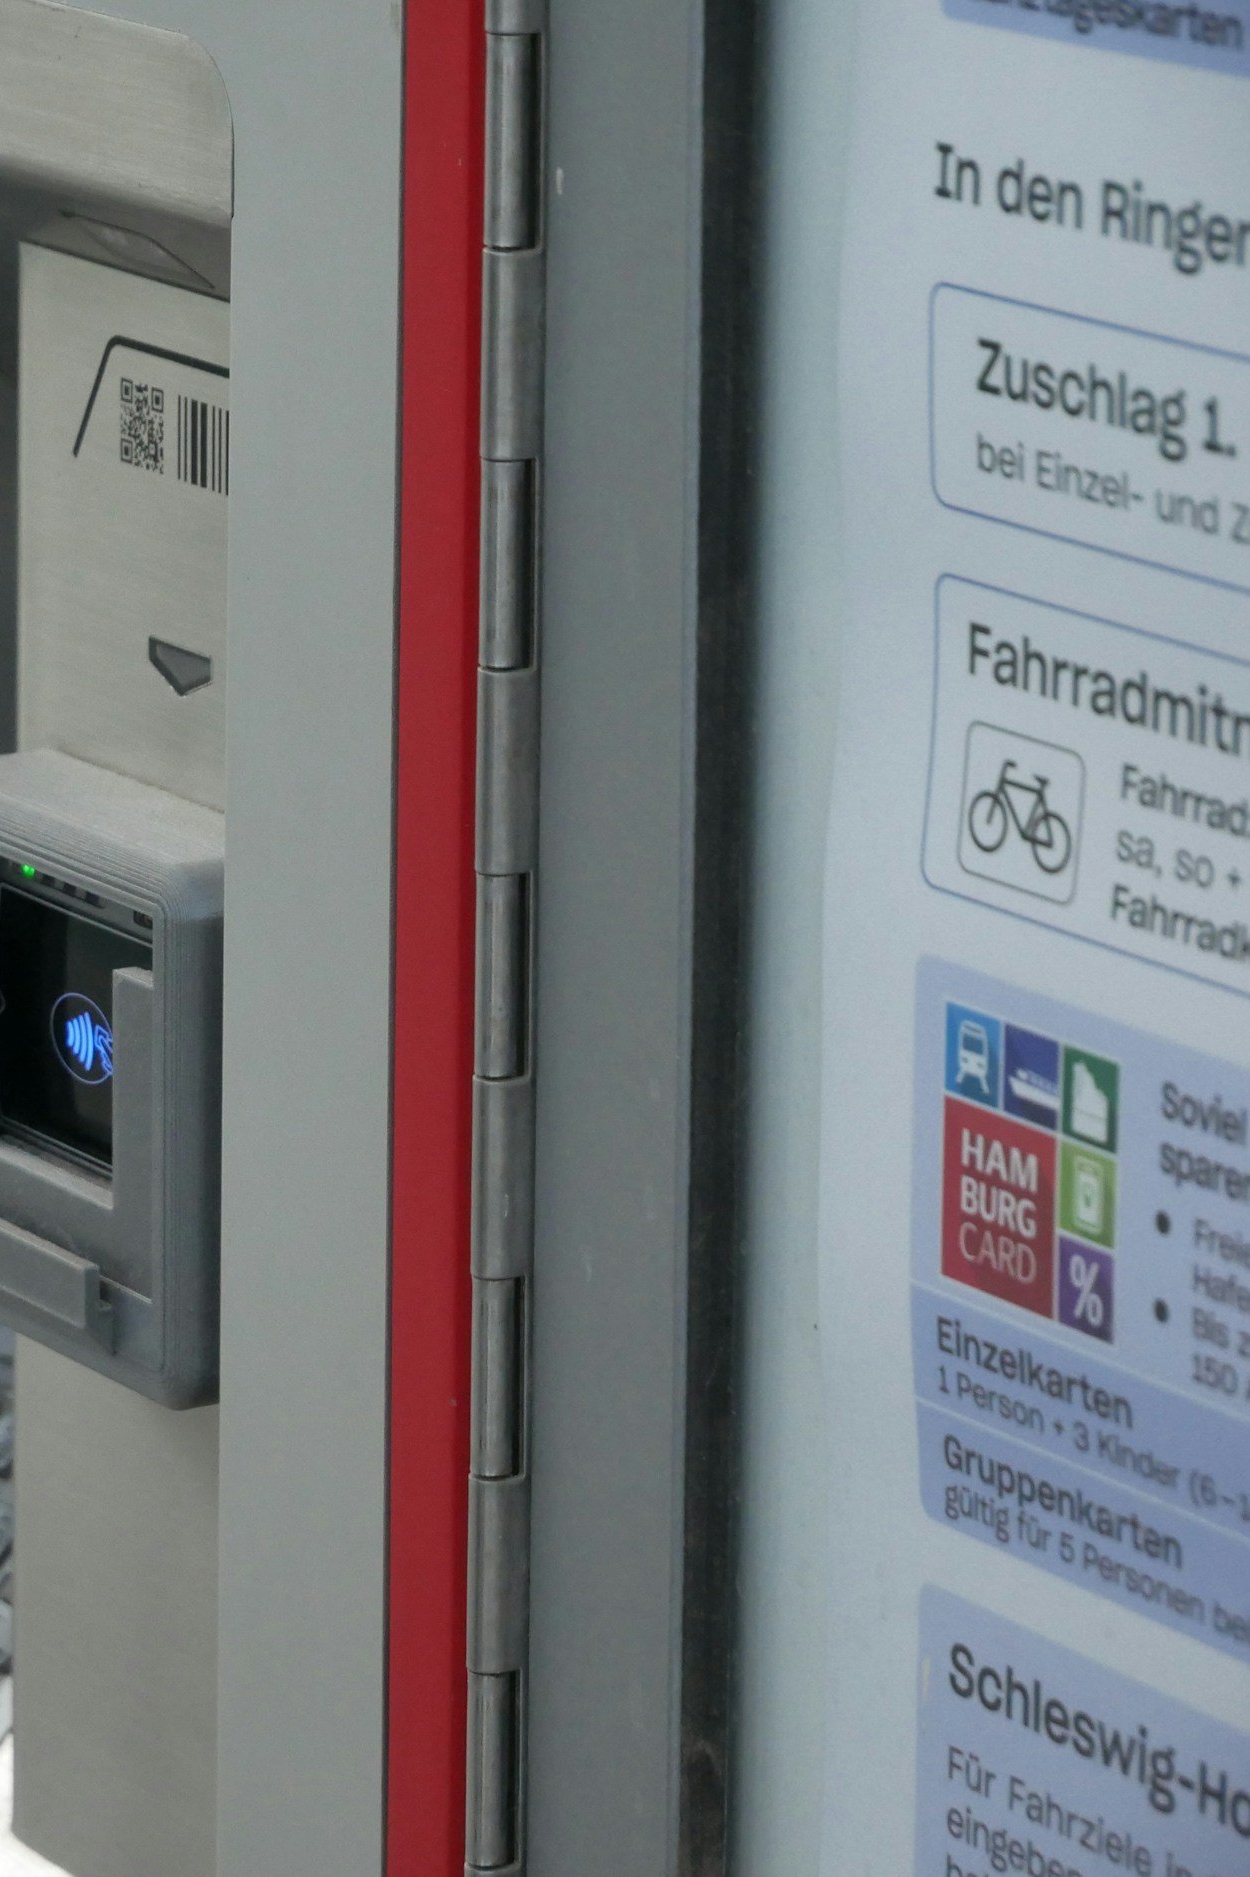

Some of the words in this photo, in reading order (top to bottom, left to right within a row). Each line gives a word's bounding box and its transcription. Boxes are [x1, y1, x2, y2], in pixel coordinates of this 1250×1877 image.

[935, 141, 981, 206] In
[997, 157, 1083, 230] den
[976, 337, 1188, 462] Zuschlag
[977, 431, 1025, 482] bei
[1036, 449, 1144, 510] Einzel-
[1155, 488, 1219, 535] und
[960, 1174, 1038, 1239] BURG
[961, 1127, 1039, 1193] HAM
[958, 1221, 1038, 1284] CARD
[937, 1315, 1134, 1429] Einzelkarten
[957, 1371, 1045, 1435] Person
[1073, 1419, 1090, 1453] 3
[943, 1433, 1183, 1570] Gruppenkarten
[944, 1484, 1010, 1543] gültig
[1018, 1508, 1051, 1551] für
[1059, 1531, 1075, 1564] 5
[1083, 1542, 1206, 1622] Personen
[948, 1743, 997, 1798] Für
[1008, 1774, 1152, 1877] Fahrziele
